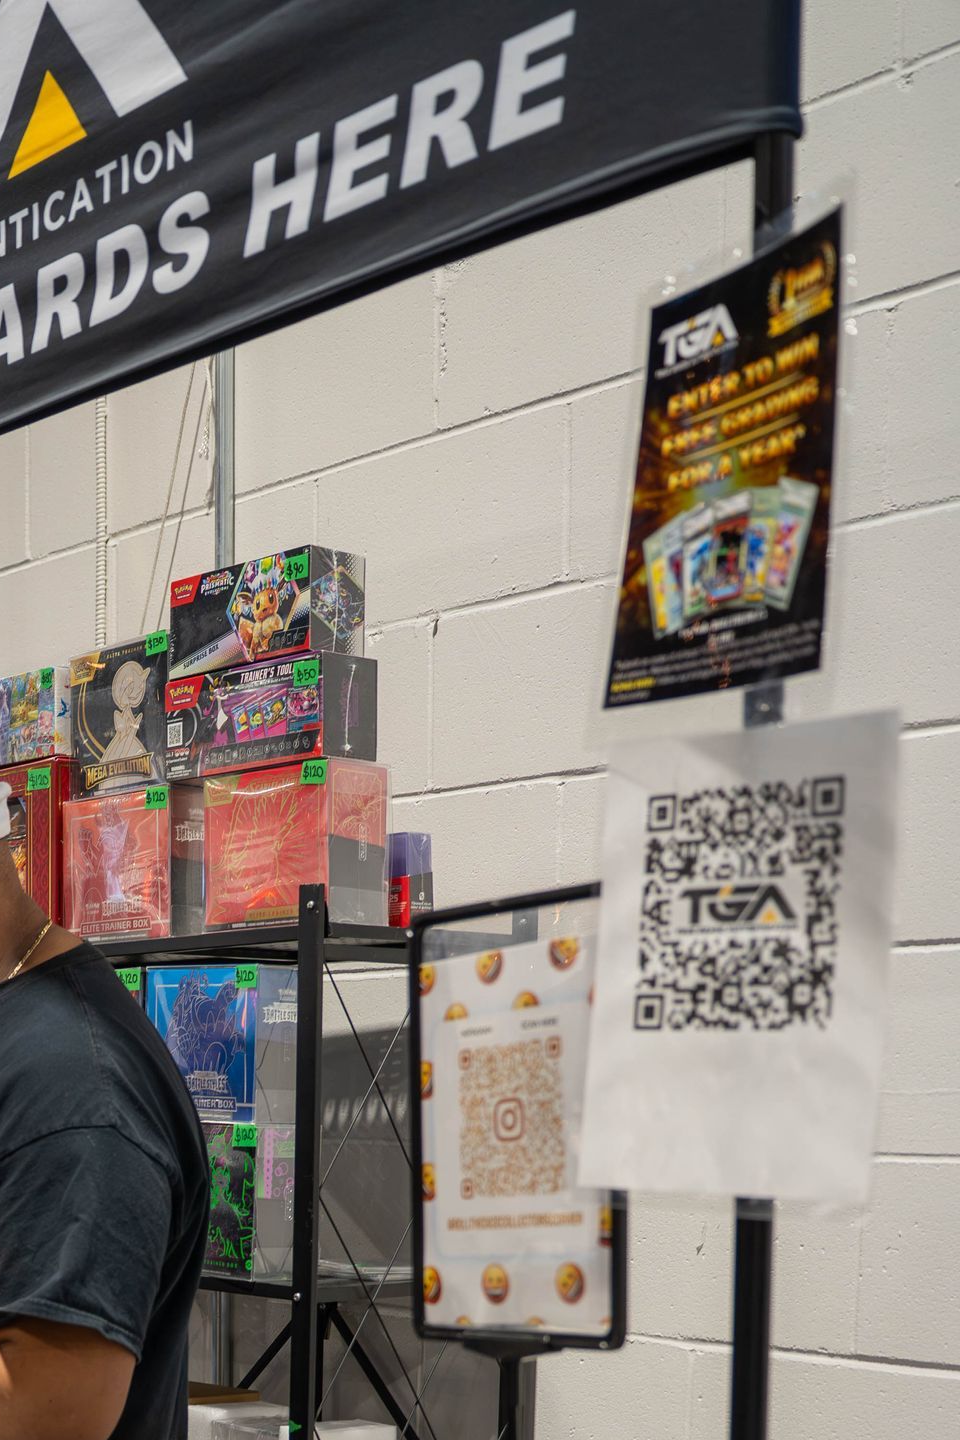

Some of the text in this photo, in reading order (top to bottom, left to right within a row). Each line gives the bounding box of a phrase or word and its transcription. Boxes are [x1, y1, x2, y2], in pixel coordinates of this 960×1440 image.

[242, 9, 577, 260] HERE
[658, 302, 740, 368] TGA
[286, 563, 304, 579] $90
[200, 576, 235, 594] PRISMATIC
[147, 638, 164, 650] $130
[183, 644, 220, 670] SURPRISE BOX
[240, 664, 275, 685] TRAINER'S
[296, 668, 317, 682] $50
[85, 765, 108, 788] MEGA
[108, 755, 152, 779] EVOLUTION
[303, 766, 324, 780] $120
[28, 771, 50, 789] $120
[145, 791, 166, 805] $120
[681, 884, 797, 925] TGA
[82, 918, 149, 934] ELITE TRAINER BOX
[235, 970, 255, 983] $120
[218, 1097, 234, 1109] BOX
[235, 1128, 255, 1143] $120
